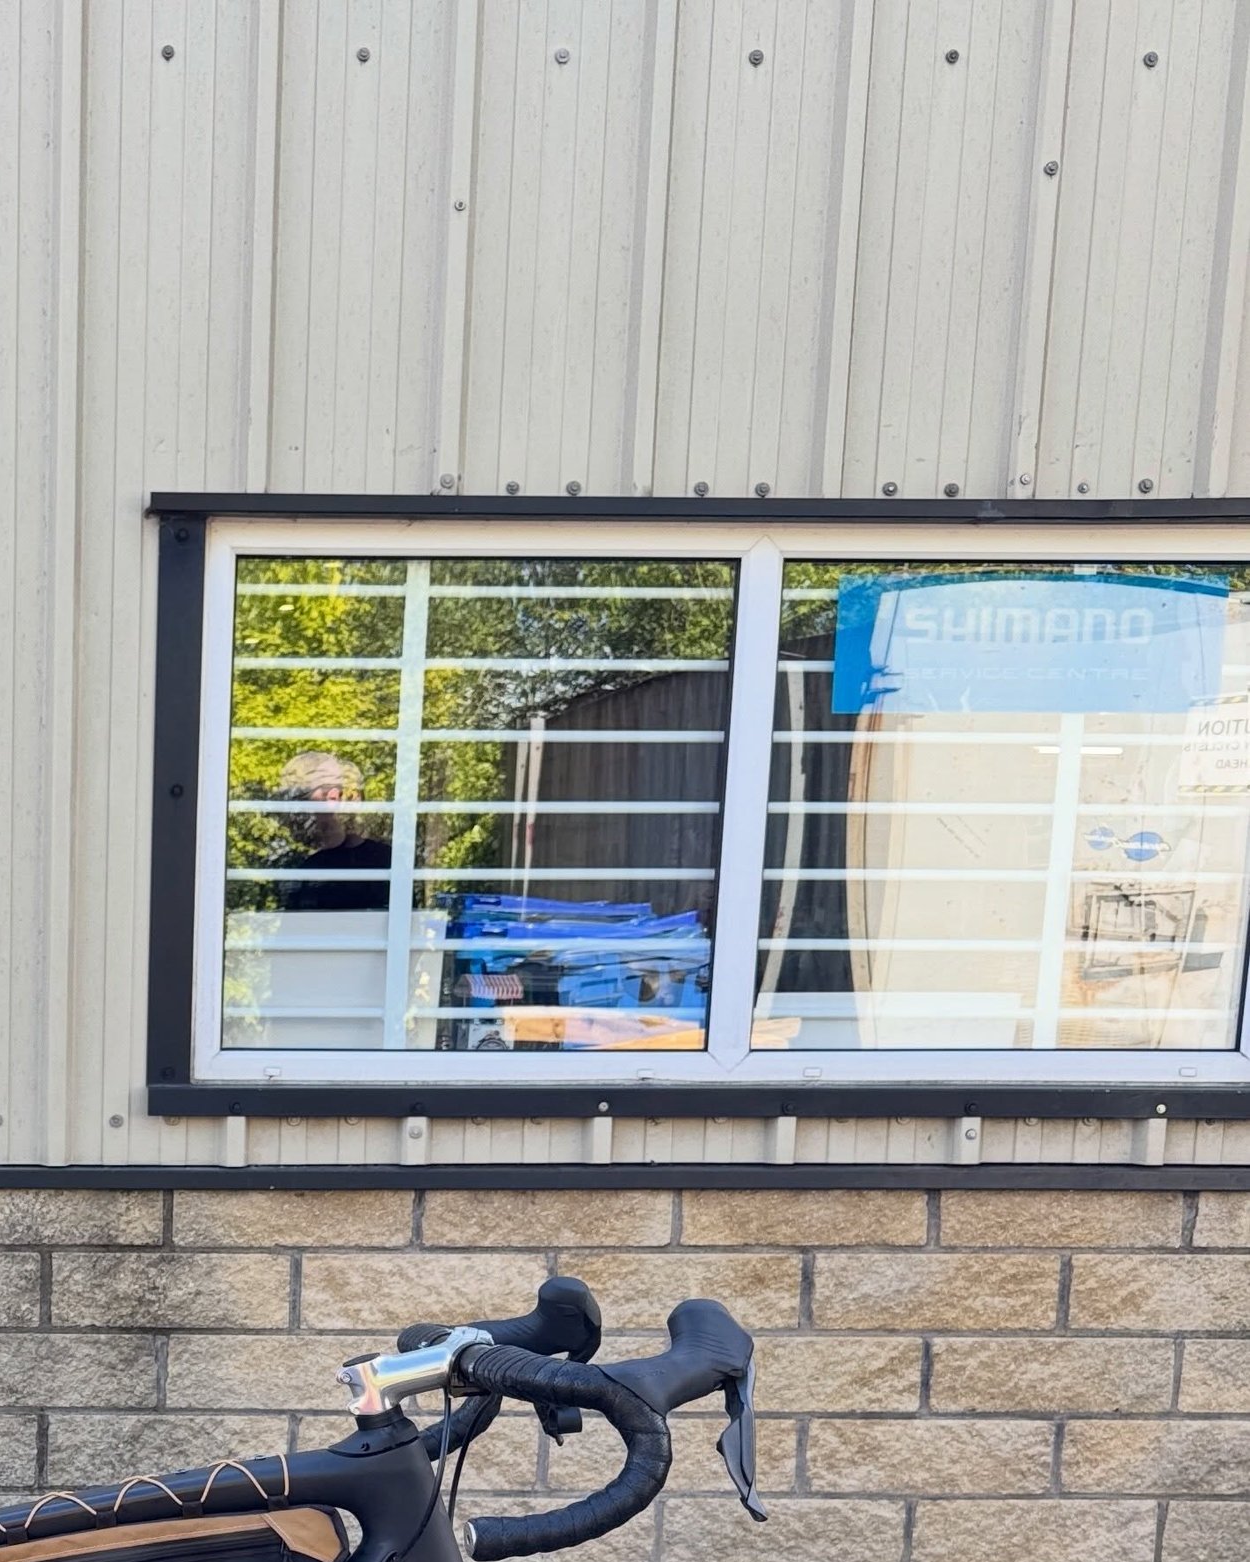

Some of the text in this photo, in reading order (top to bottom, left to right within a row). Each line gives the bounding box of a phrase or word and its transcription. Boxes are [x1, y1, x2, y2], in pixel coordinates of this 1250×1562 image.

[904, 607, 1154, 644] SHIMANO
[904, 667, 1149, 680] SERVICE CENTRE
